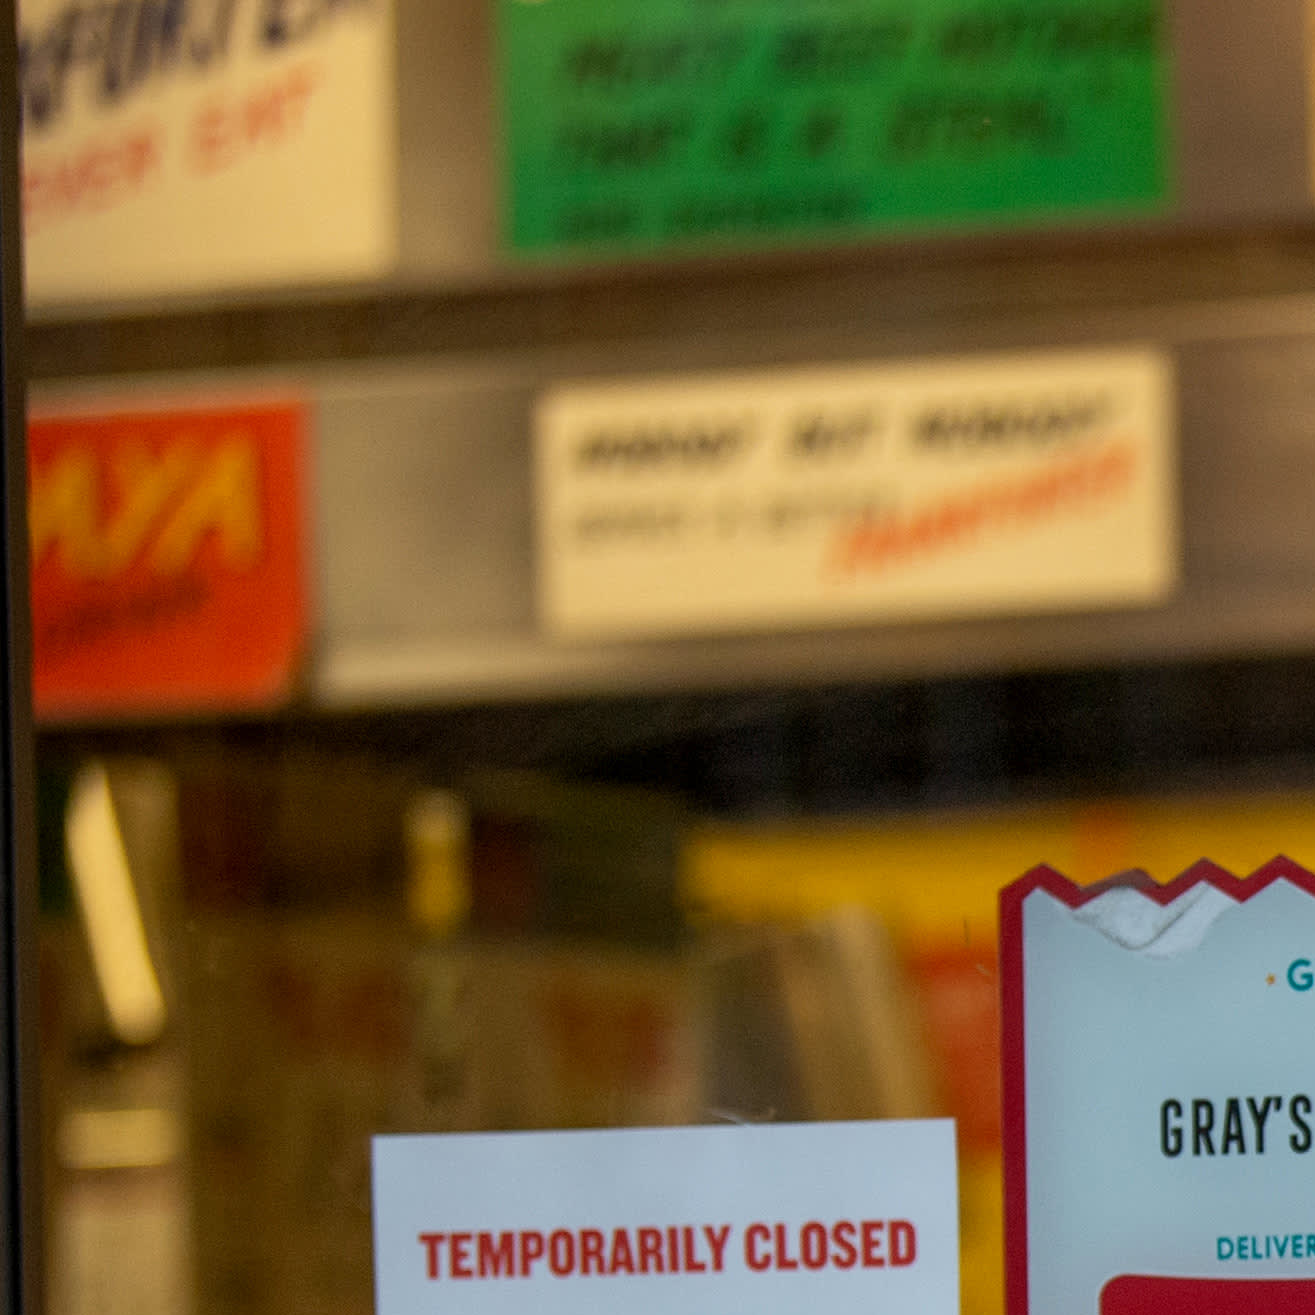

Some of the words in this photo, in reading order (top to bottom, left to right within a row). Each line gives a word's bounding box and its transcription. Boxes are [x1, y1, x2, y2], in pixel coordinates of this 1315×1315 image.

[1161, 1094, 1312, 1157] GRAY'S
[419, 1225, 730, 1280] TEMPORARILY
[744, 1220, 916, 1272] CLOSED
